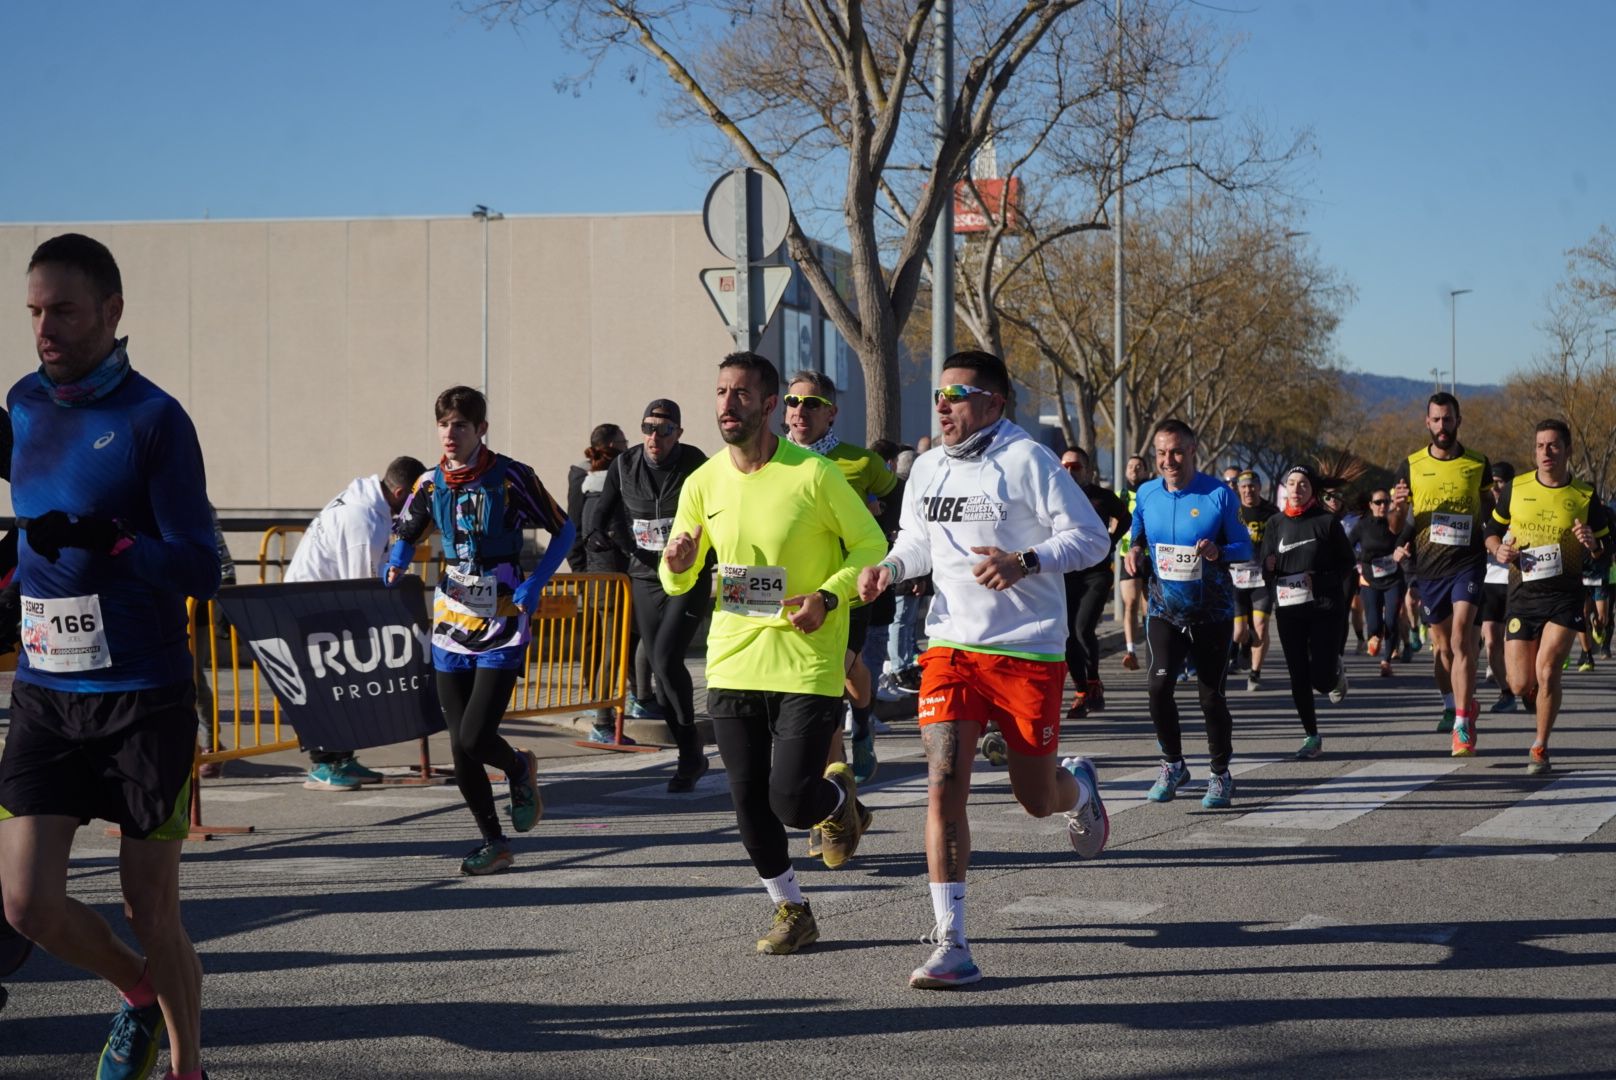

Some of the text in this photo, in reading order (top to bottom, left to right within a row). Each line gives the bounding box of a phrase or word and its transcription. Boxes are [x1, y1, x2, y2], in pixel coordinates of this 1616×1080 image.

[965, 503, 1003, 512] SILVESTE
[964, 511, 1007, 521] MANRESAA
[1450, 521, 1470, 530] 438
[1520, 523, 1572, 537] MONTERO
[1176, 554, 1200, 563] 337
[1537, 552, 1558, 562] 437
[724, 566, 747, 577] SSM23
[467, 583, 492, 597] 171
[749, 577, 783, 591] 254
[25, 600, 45, 615] SSM23
[50, 614, 96, 634] 166
[306, 623, 432, 679] RUDY
[332, 674, 430, 701] PROJECT
